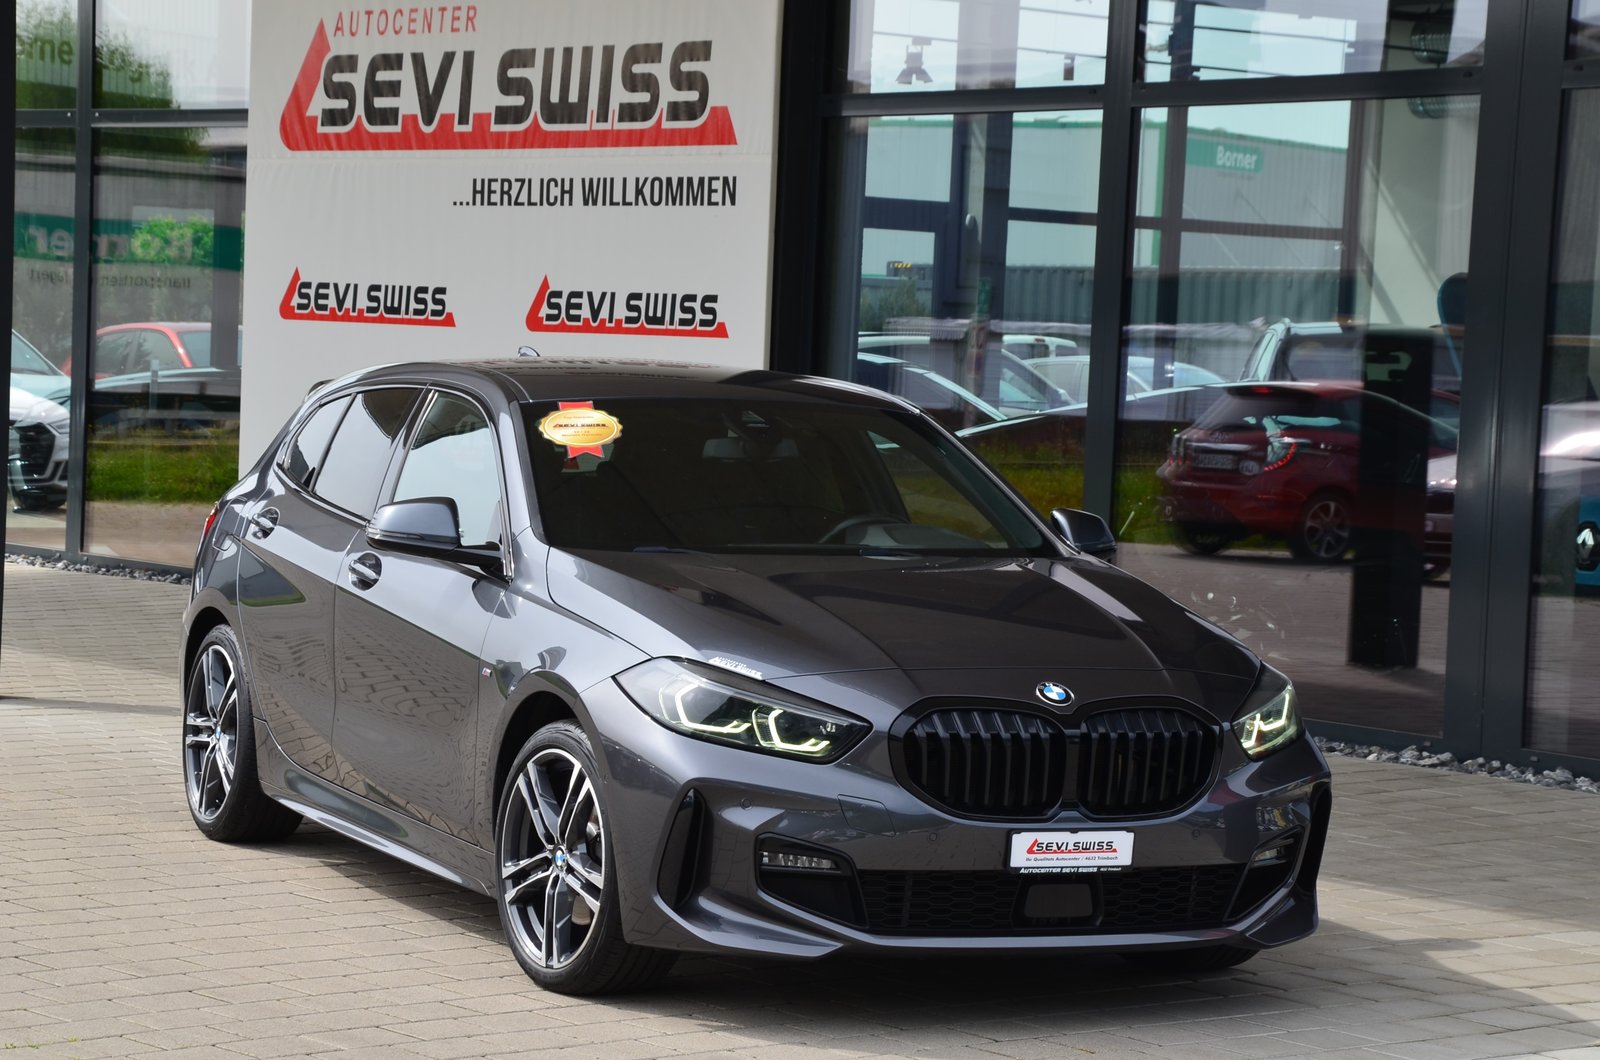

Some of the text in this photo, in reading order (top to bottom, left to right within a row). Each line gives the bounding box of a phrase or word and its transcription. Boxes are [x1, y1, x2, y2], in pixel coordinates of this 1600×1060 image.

[333, 5, 478, 37] AUTOCENTER
[320, 40, 713, 128] SEVI SWISS
[1216, 145, 1259, 169] Borner
[581, 176, 737, 206] WILLKOMMEN
[296, 281, 447, 318] SEVI SWISS
[545, 290, 718, 327] SEVI SWISS
[1035, 841, 1114, 852] SEVI SWISS
